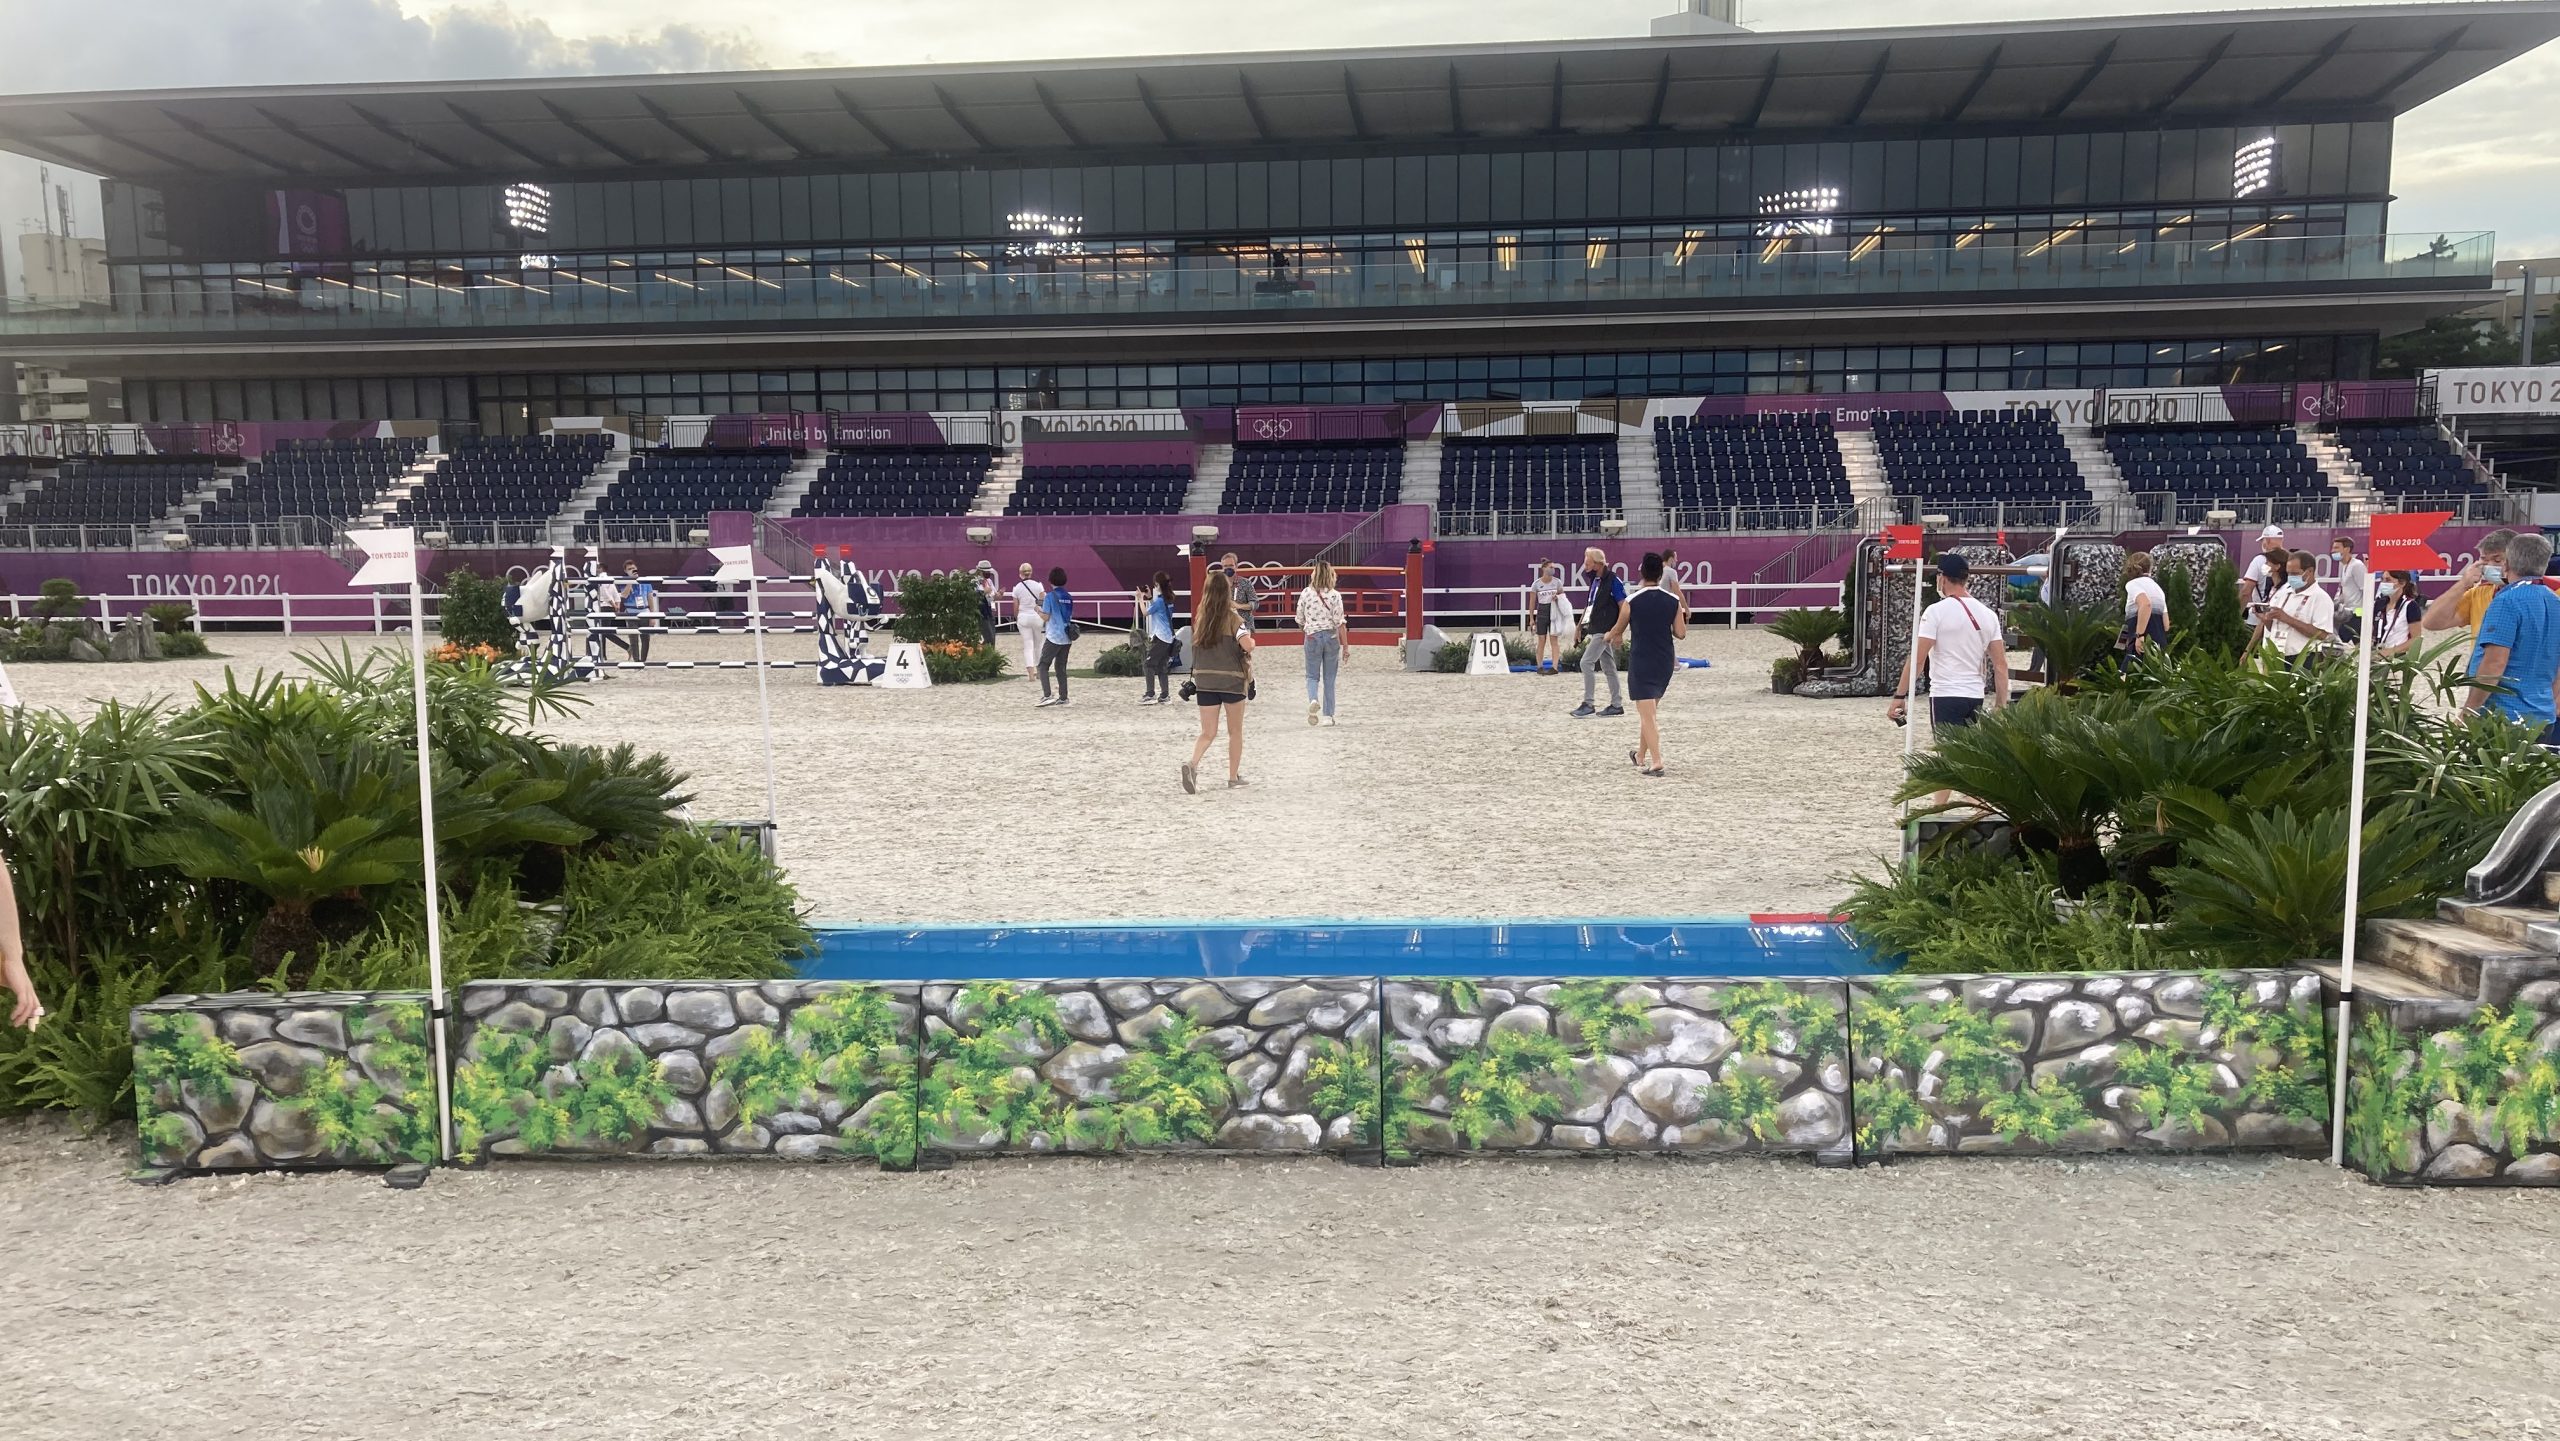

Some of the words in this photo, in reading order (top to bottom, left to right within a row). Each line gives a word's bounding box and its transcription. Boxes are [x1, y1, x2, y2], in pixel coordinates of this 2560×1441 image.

[2453, 381, 2543, 404] TOKYO
[2109, 398, 2178, 423] 2020
[2375, 539, 2401, 547] TOKYO
[2402, 538, 2422, 546] 2020
[393, 551, 409, 559] 2020
[127, 574, 217, 596] TOKYO
[1480, 638, 1500, 657] 10
[896, 649, 909, 670] 4
